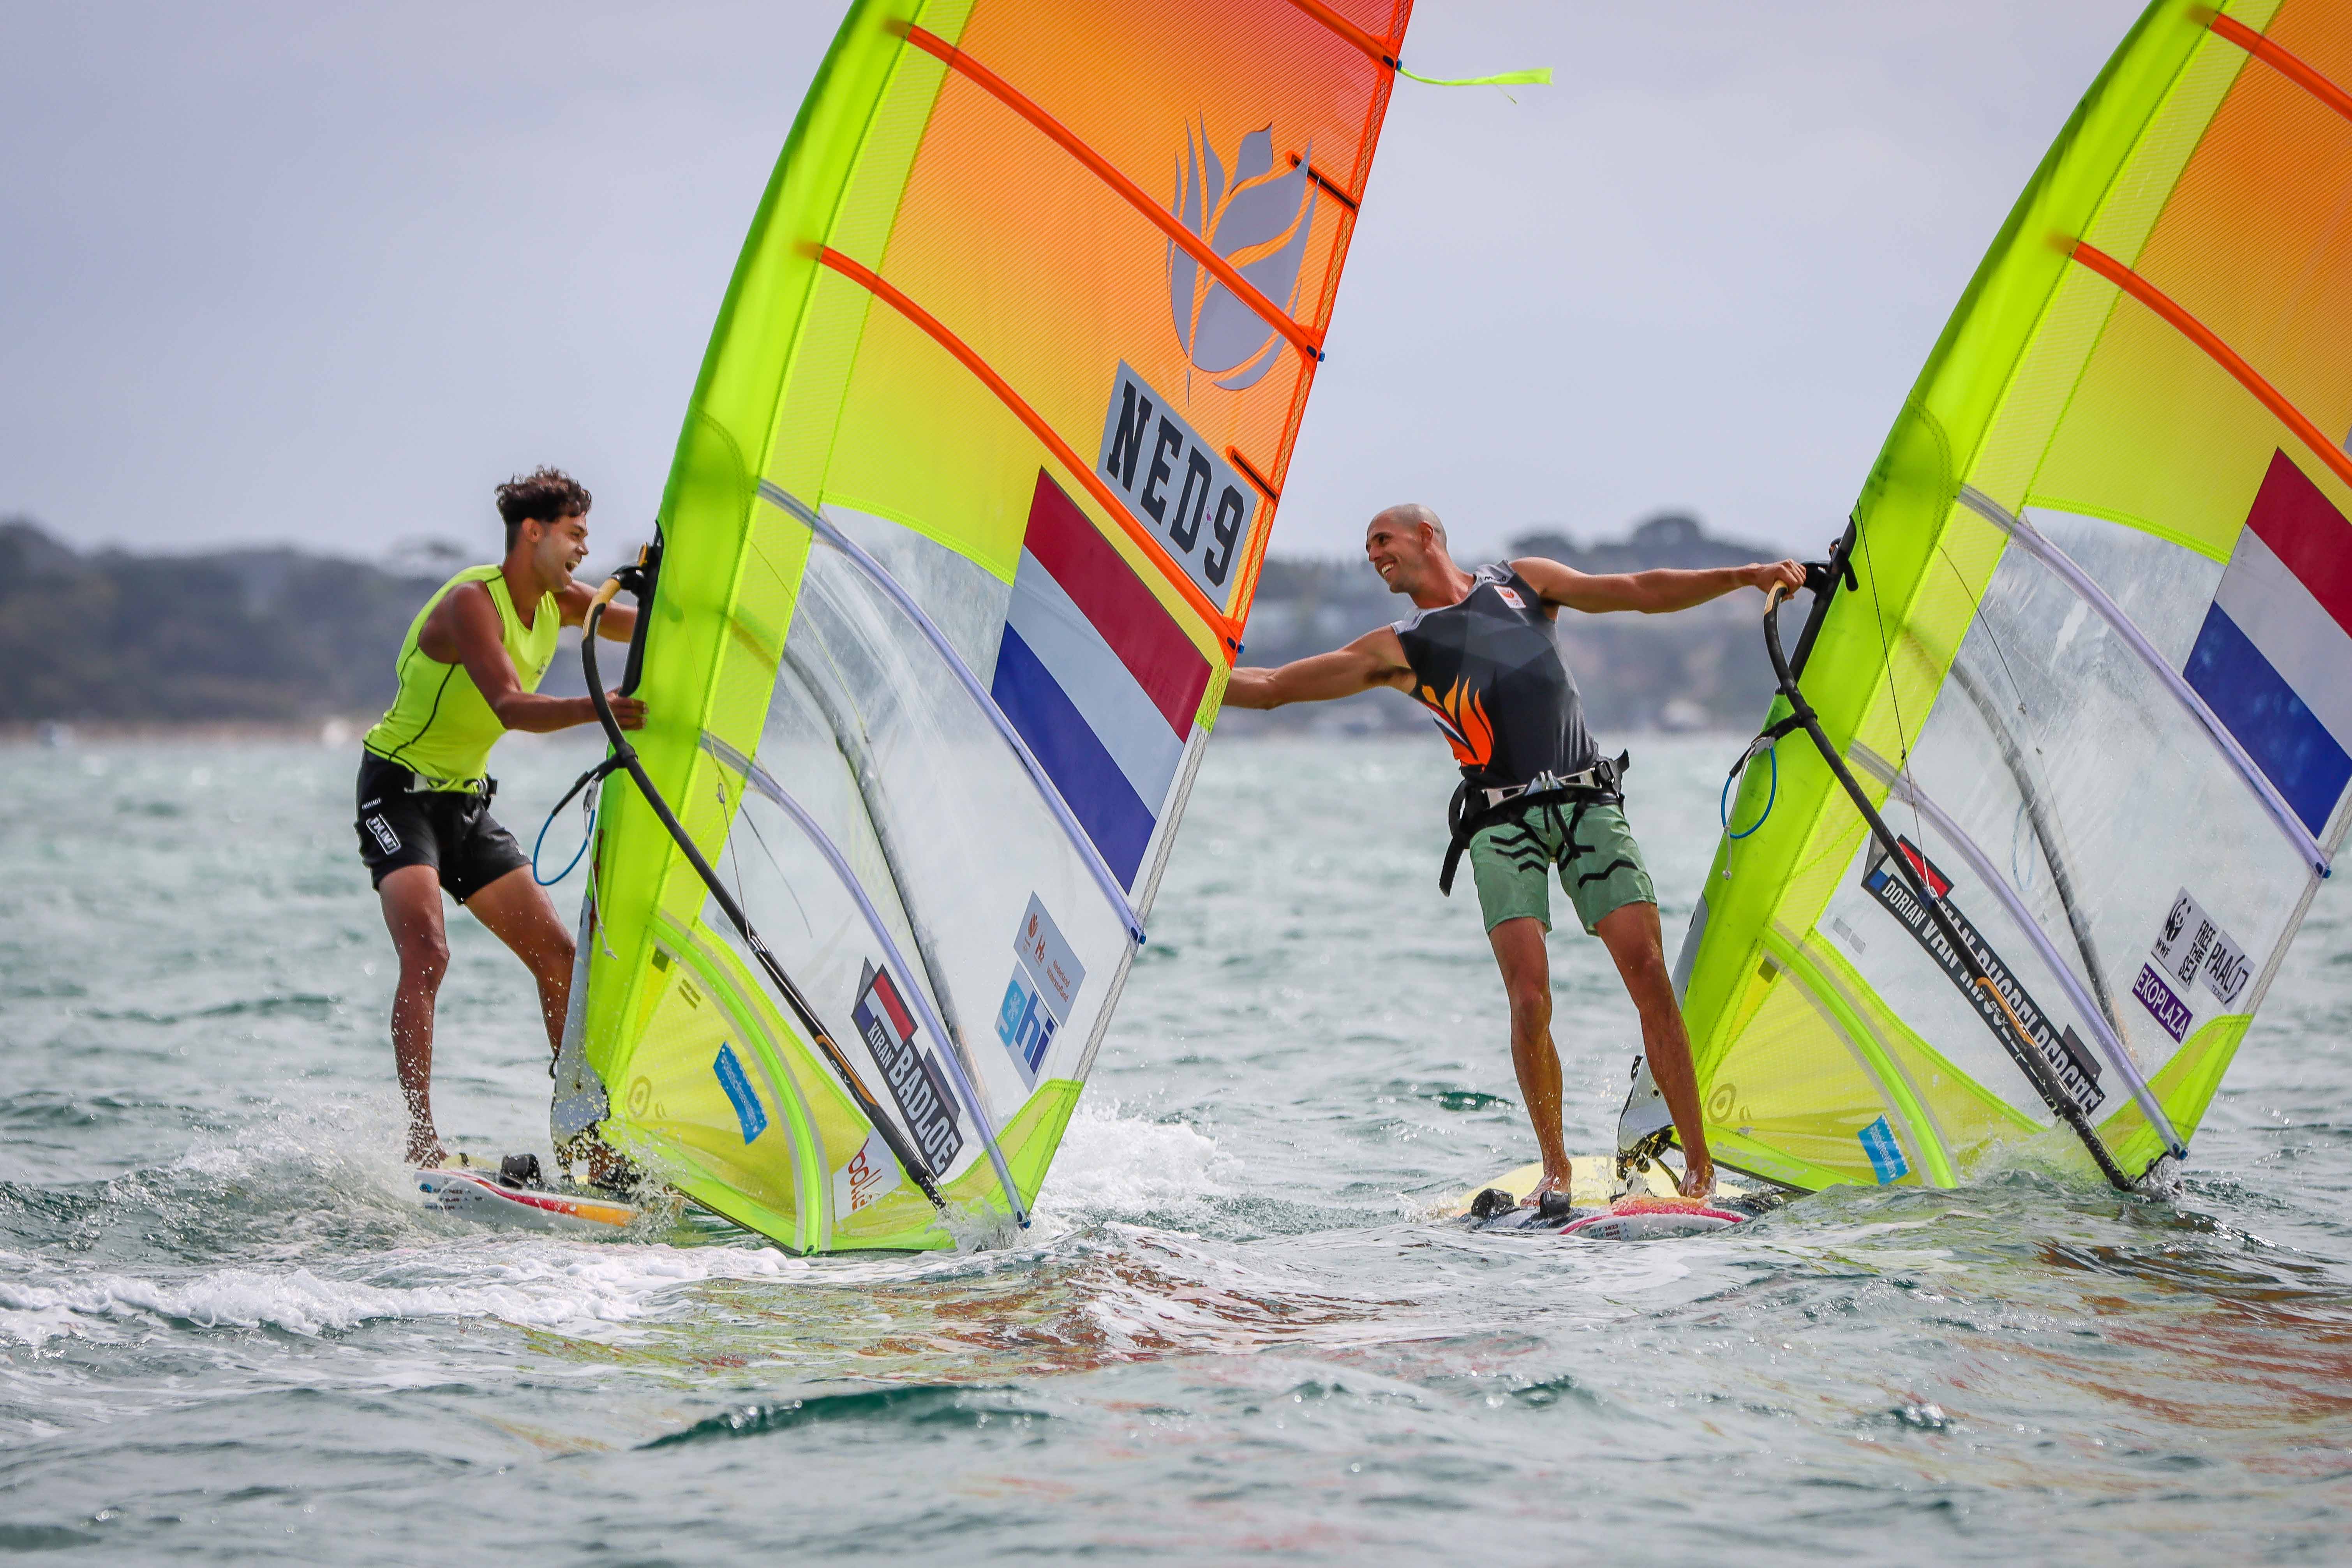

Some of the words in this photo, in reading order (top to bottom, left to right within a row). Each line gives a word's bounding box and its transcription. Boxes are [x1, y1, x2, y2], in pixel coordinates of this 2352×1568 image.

[1882, 881, 1926, 928] DORIAN
[2155, 937, 2171, 959] WWF
[2190, 941, 2205, 964] THE
[2195, 920, 2216, 952] FREE
[2178, 956, 2197, 986] SEA
[2134, 967, 2188, 1039] EKOPLAZA
[867, 1024, 895, 1069] KIRAN
[888, 1044, 959, 1174] BADLOE
